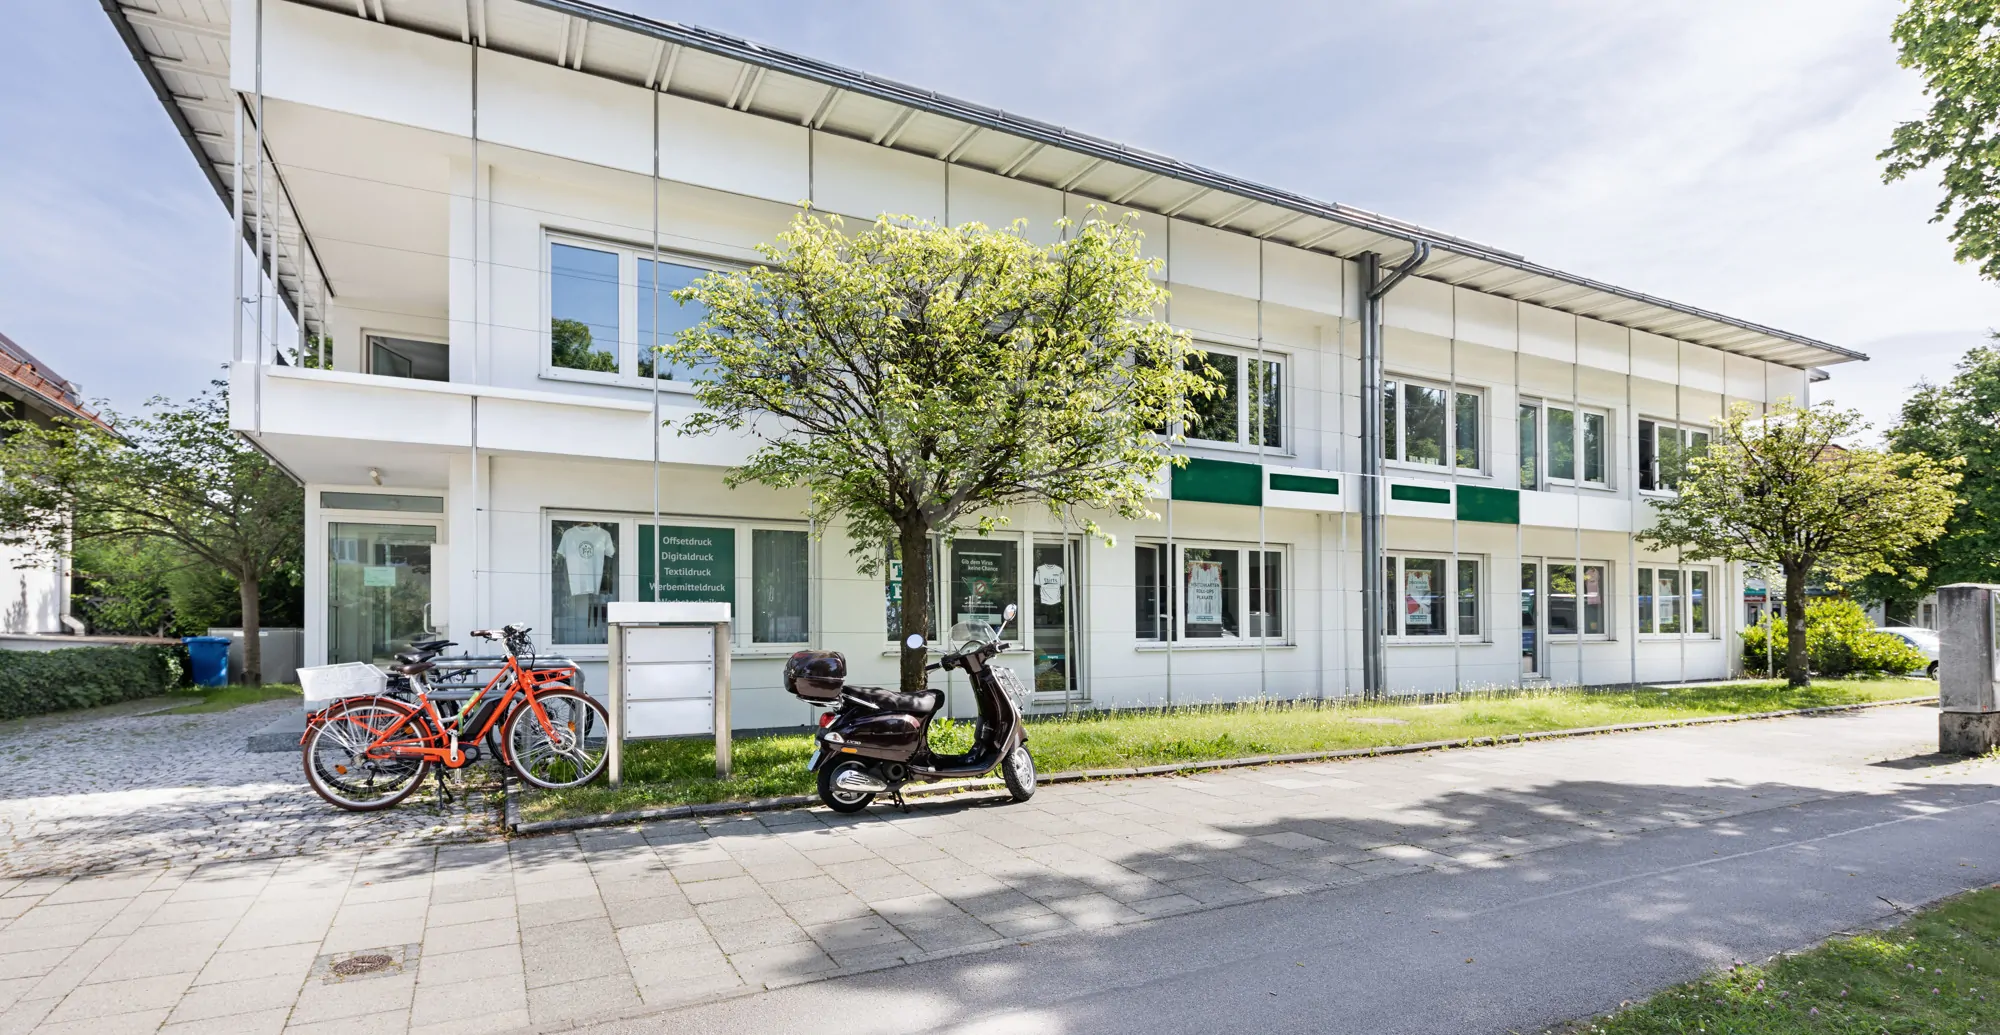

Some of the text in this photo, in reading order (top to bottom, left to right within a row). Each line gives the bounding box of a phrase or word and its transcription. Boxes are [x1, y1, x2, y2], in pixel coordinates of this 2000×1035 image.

[662, 536, 712, 546] Offsetdruck
[661, 551, 714, 562] Digitaldruck
[664, 567, 711, 576] Textildruck
[649, 582, 726, 592] Werbemitteldruck
